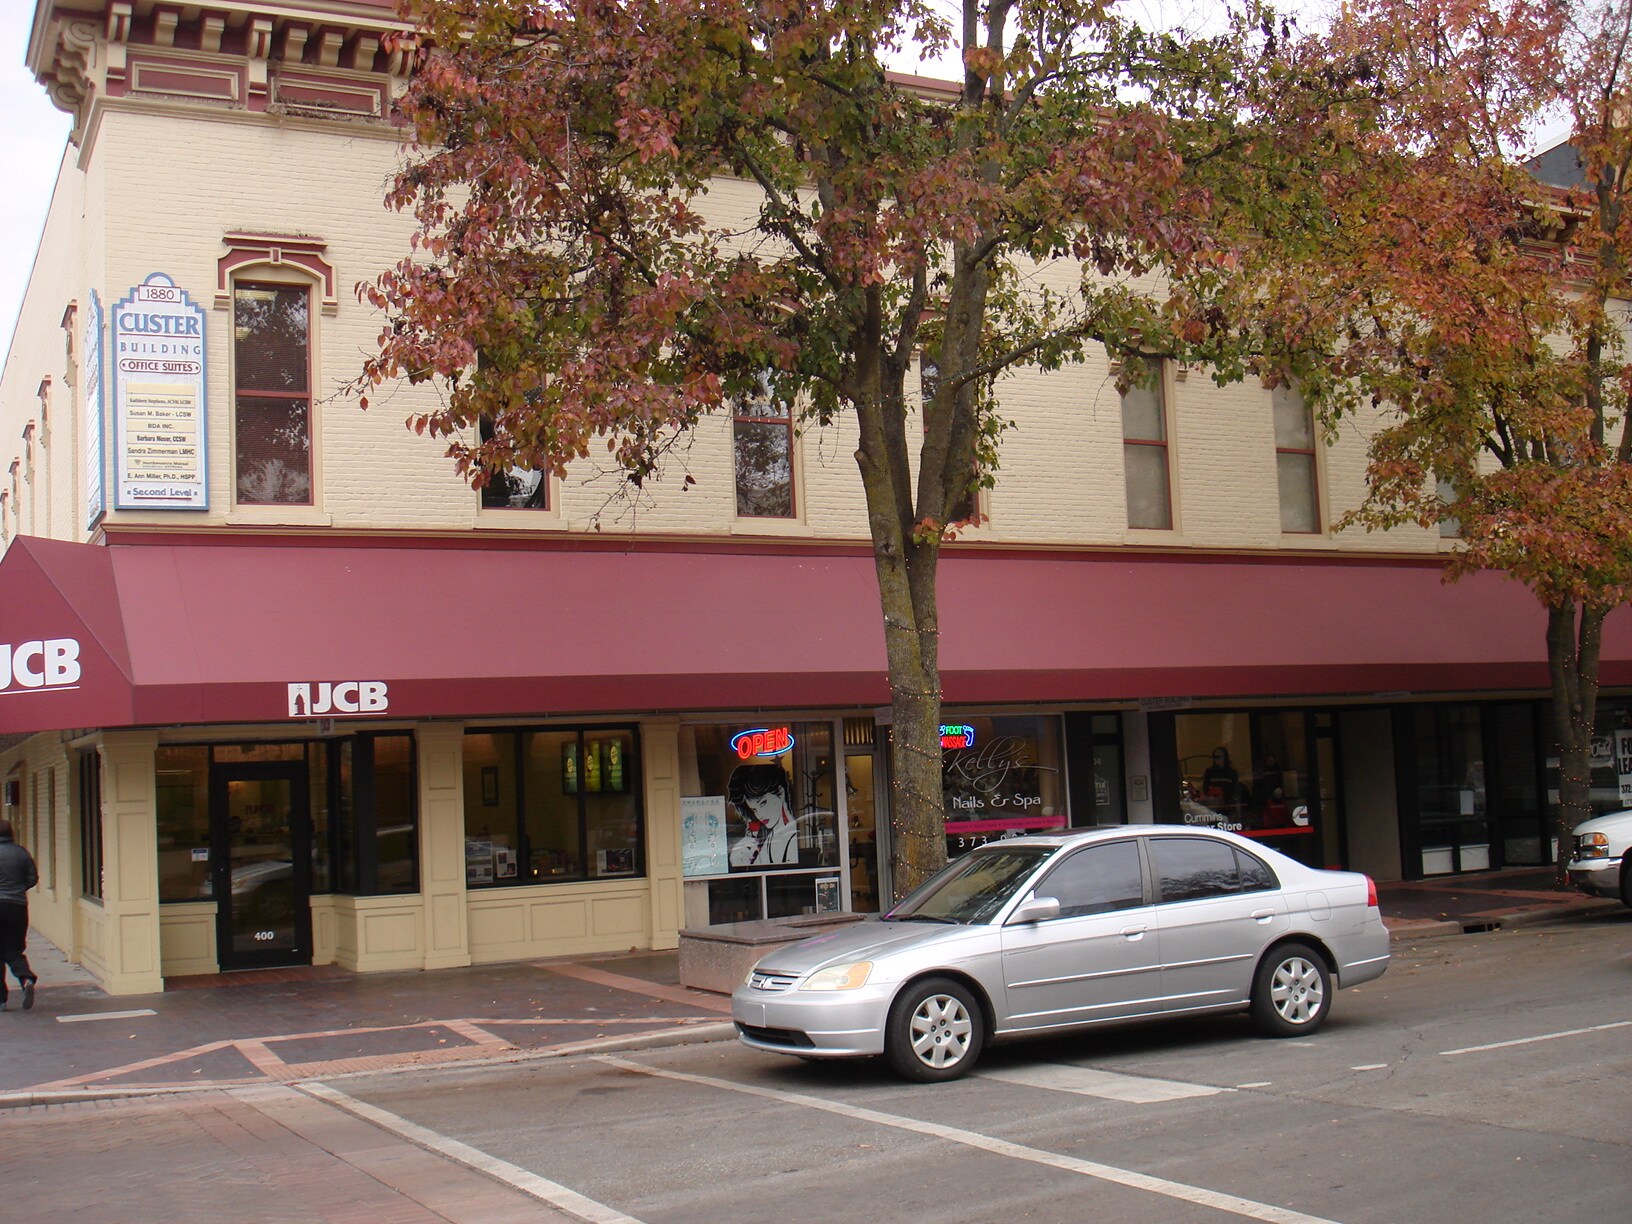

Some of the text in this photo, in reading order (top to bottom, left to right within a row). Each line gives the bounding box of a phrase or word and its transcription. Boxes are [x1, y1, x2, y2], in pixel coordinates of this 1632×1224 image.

[146, 289, 175, 300] 1880
[119, 312, 200, 335] CUSTER
[120, 342, 201, 355] BUILDING
[128, 361, 193, 372] OFFICE SUITES
[133, 487, 192, 496] Second Level
[312, 681, 389, 714] JCB
[945, 725, 963, 735] FOOT
[737, 727, 789, 759] OPEN
[942, 736, 1059, 793] Kelly's
[952, 793, 1041, 810] Nails & Spa
[1184, 813, 1223, 824] Cummins
[1216, 822, 1243, 831] Store
[254, 931, 275, 941] 400
